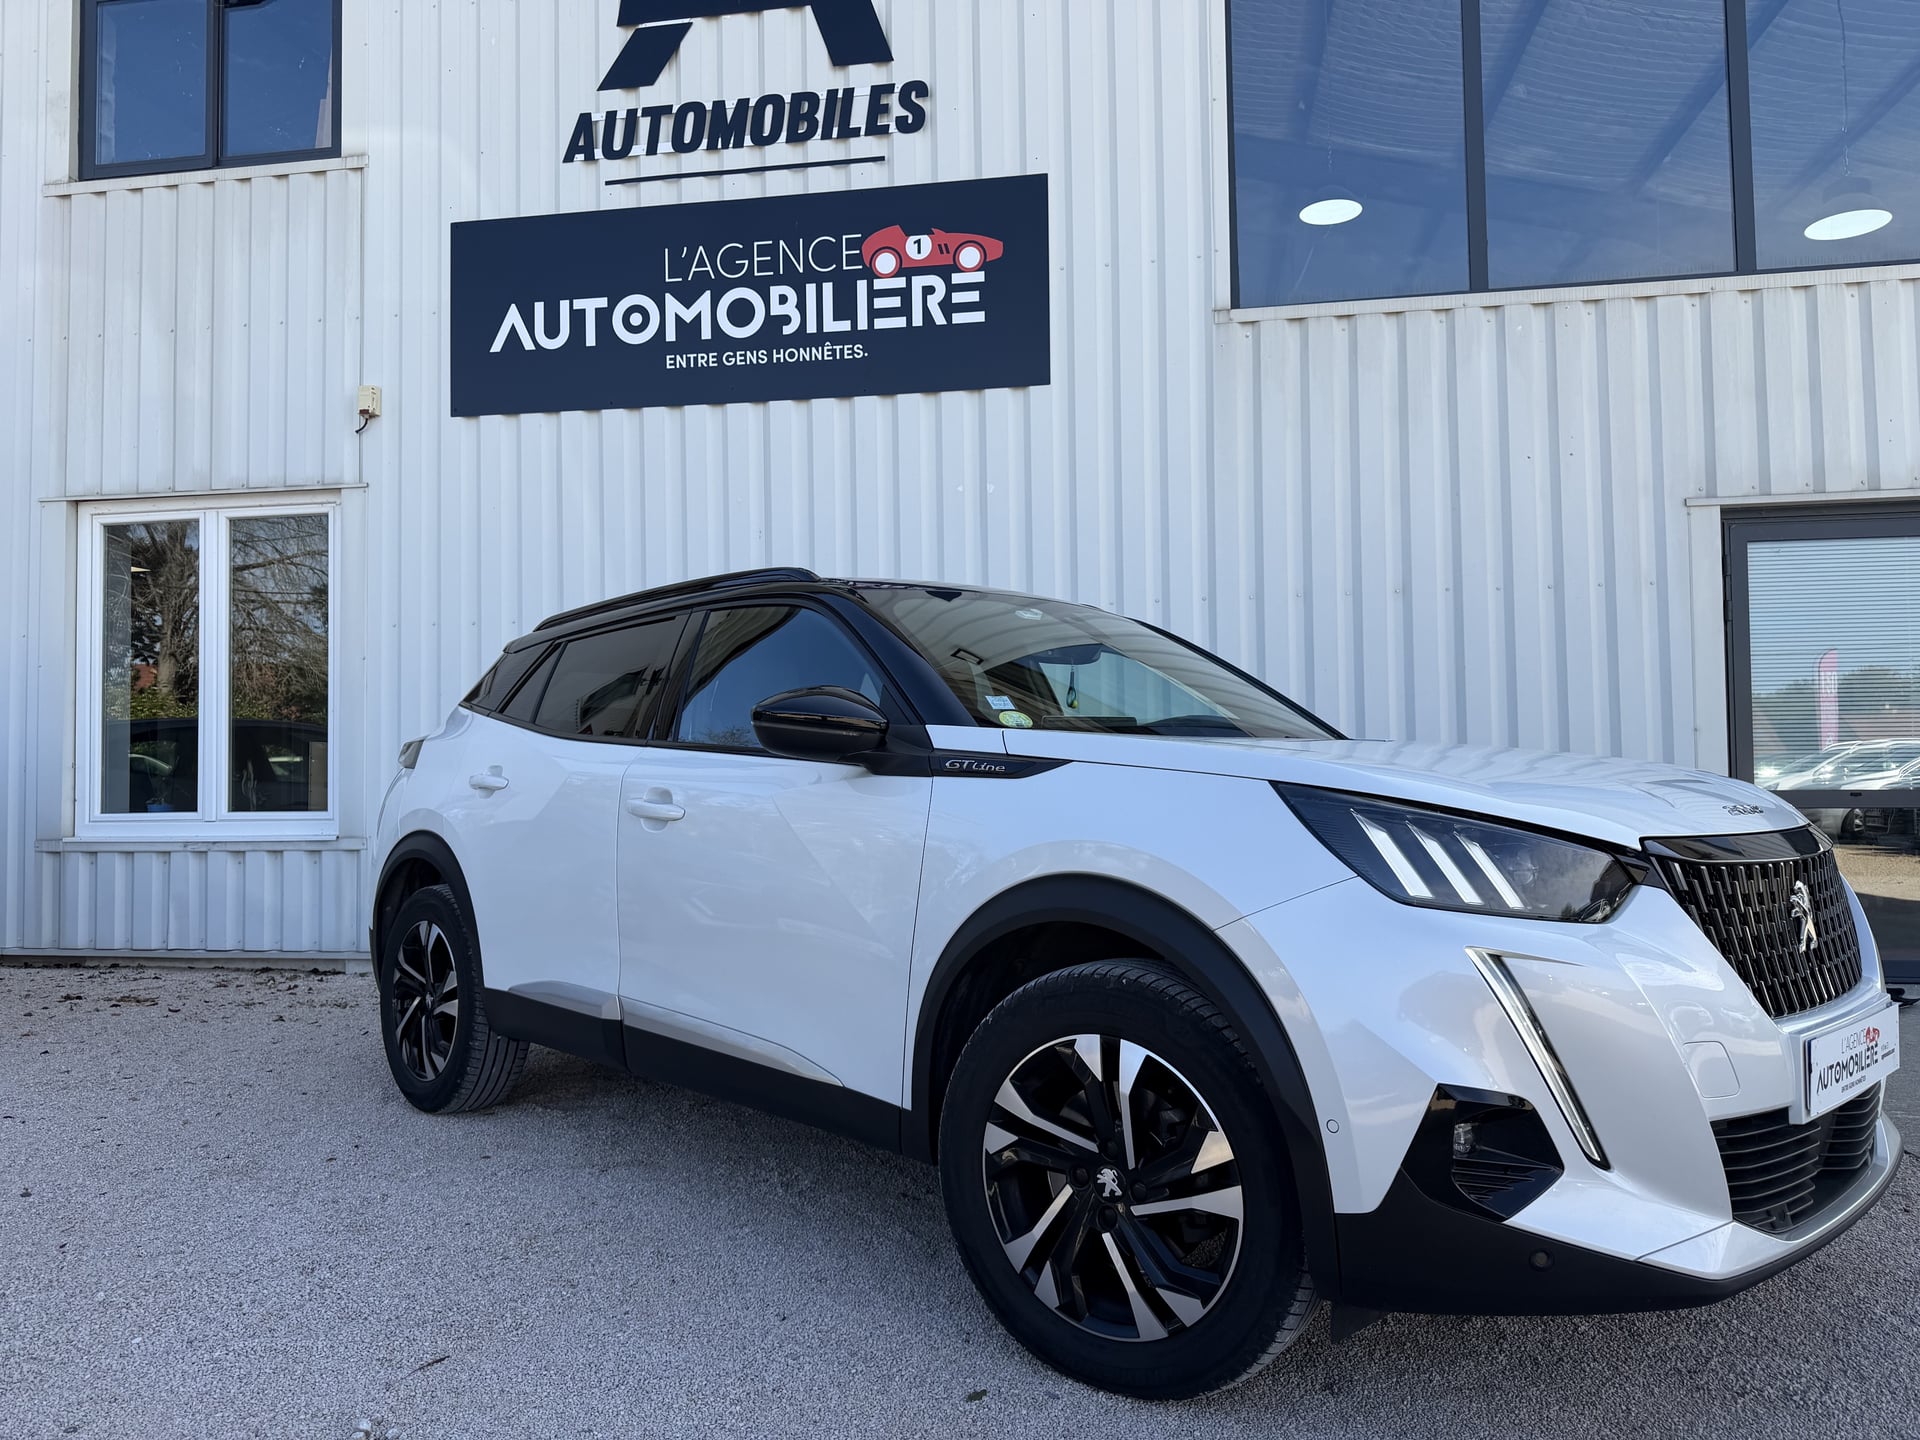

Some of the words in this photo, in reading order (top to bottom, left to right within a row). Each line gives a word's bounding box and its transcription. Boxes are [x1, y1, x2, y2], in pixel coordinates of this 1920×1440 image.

[562, 79, 930, 164] AUTOMOBILES
[663, 232, 863, 283] L'AGENCE
[665, 352, 719, 370] ENTRE
[722, 349, 768, 367] GENS
[772, 341, 869, 364] HONNÊTES.
